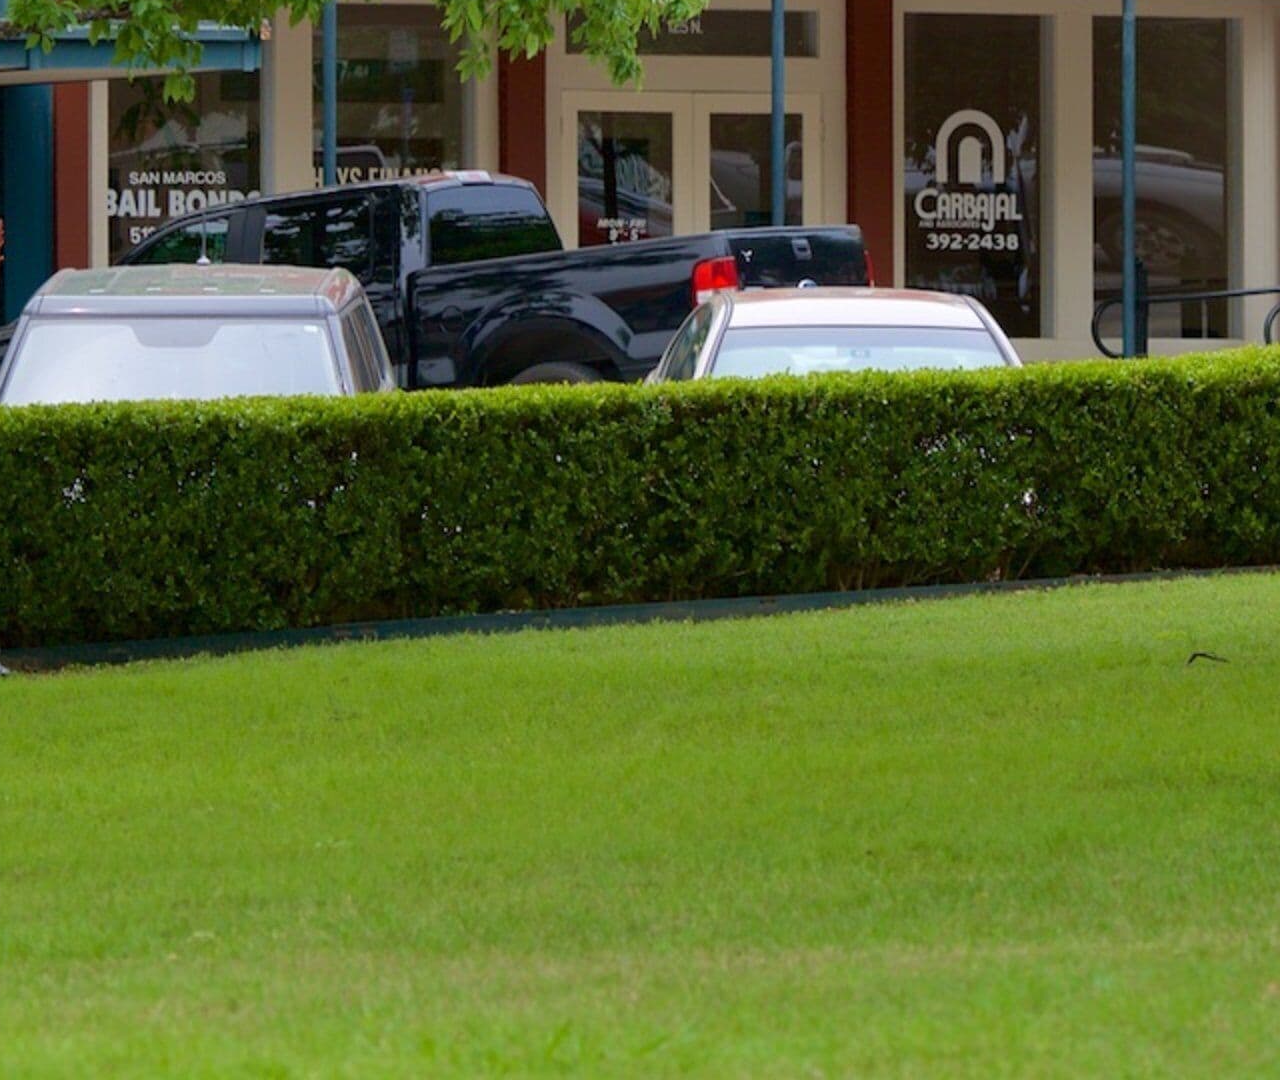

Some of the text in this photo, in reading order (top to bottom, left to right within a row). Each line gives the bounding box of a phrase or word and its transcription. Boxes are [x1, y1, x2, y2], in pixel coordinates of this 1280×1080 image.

[129, 171, 226, 185] SAN MARCOS
[107, 189, 162, 217] BAIL
[914, 188, 1023, 231] CARBAJAL
